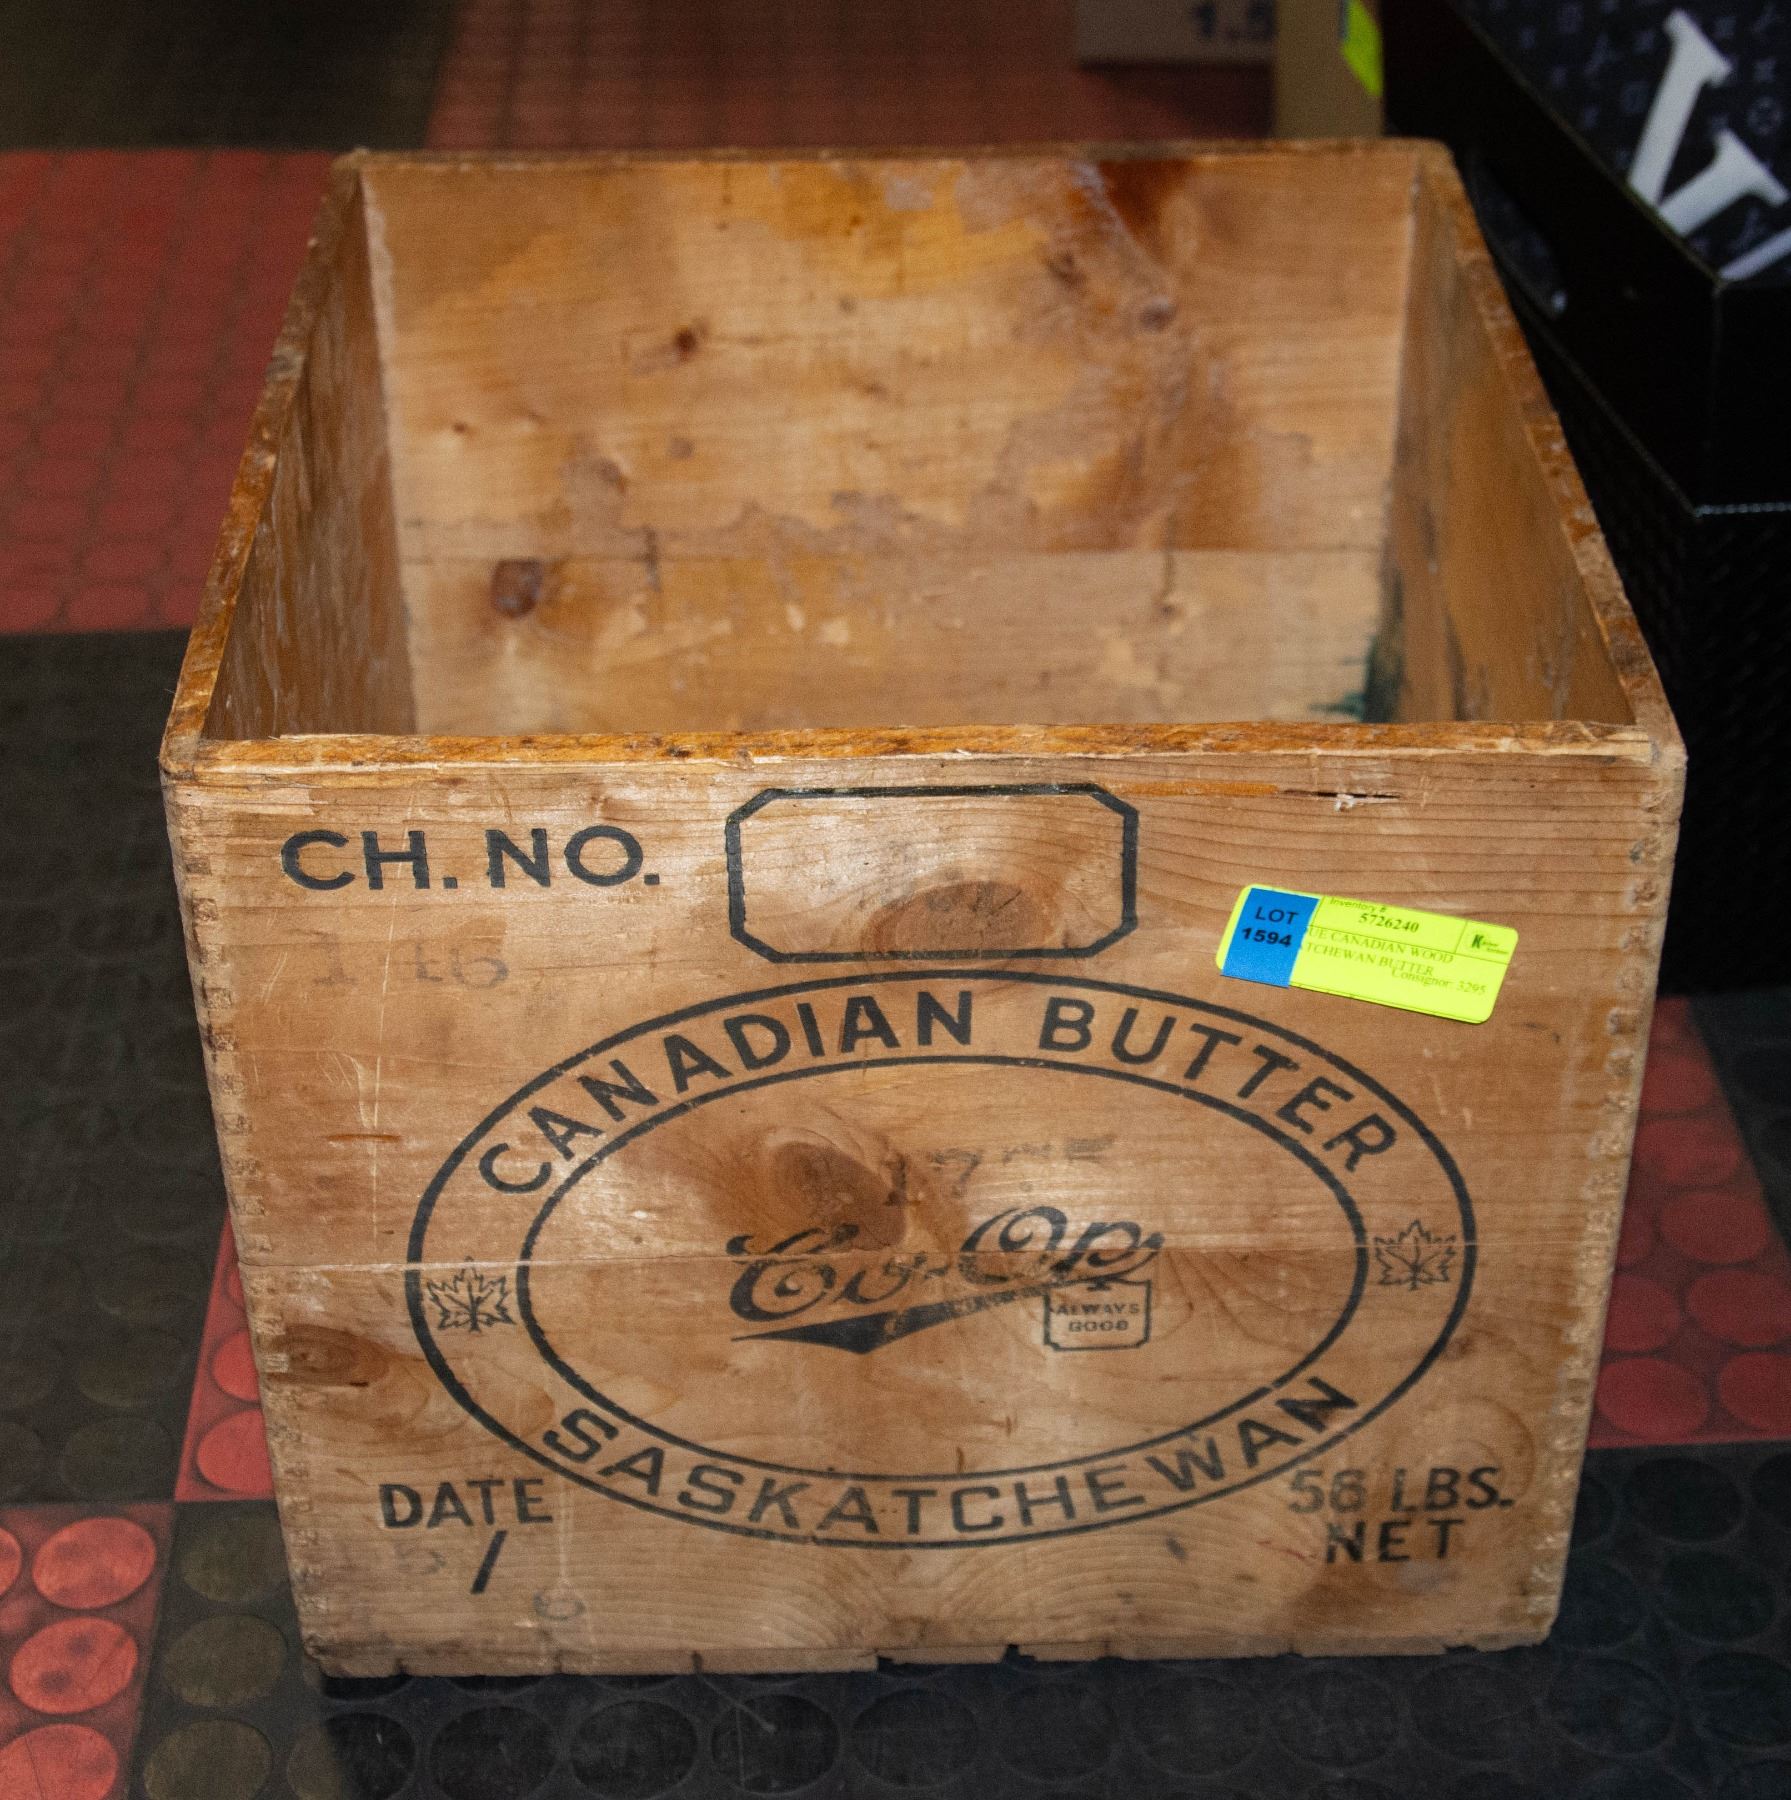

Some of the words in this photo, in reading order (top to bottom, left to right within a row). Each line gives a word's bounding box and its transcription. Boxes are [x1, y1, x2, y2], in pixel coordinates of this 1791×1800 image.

[281, 829, 458, 890] CH.
[486, 825, 660, 888] NO.
[1254, 905, 1299, 925] LOT
[1329, 897, 1377, 913] Inventory
[1358, 912, 1420, 933] 5726240
[1242, 927, 1292, 948] 1594
[1330, 931, 1407, 955] CANADIAN
[1410, 946, 1455, 965] WOOD
[1379, 956, 1435, 977] BUTTER
[477, 990, 973, 1195] CANADIAN
[1038, 996, 1398, 1173] BUTTER
[1056, 1303, 1140, 1316] ALWAYS
[1068, 1319, 1129, 1333] GOOD
[542, 1376, 1360, 1537] SASKATCHEWAN
[378, 1476, 554, 1530] DATE
[1287, 1467, 1367, 1514] 56
[1390, 1466, 1516, 1512] LBS.
[1325, 1518, 1466, 1564] NET
